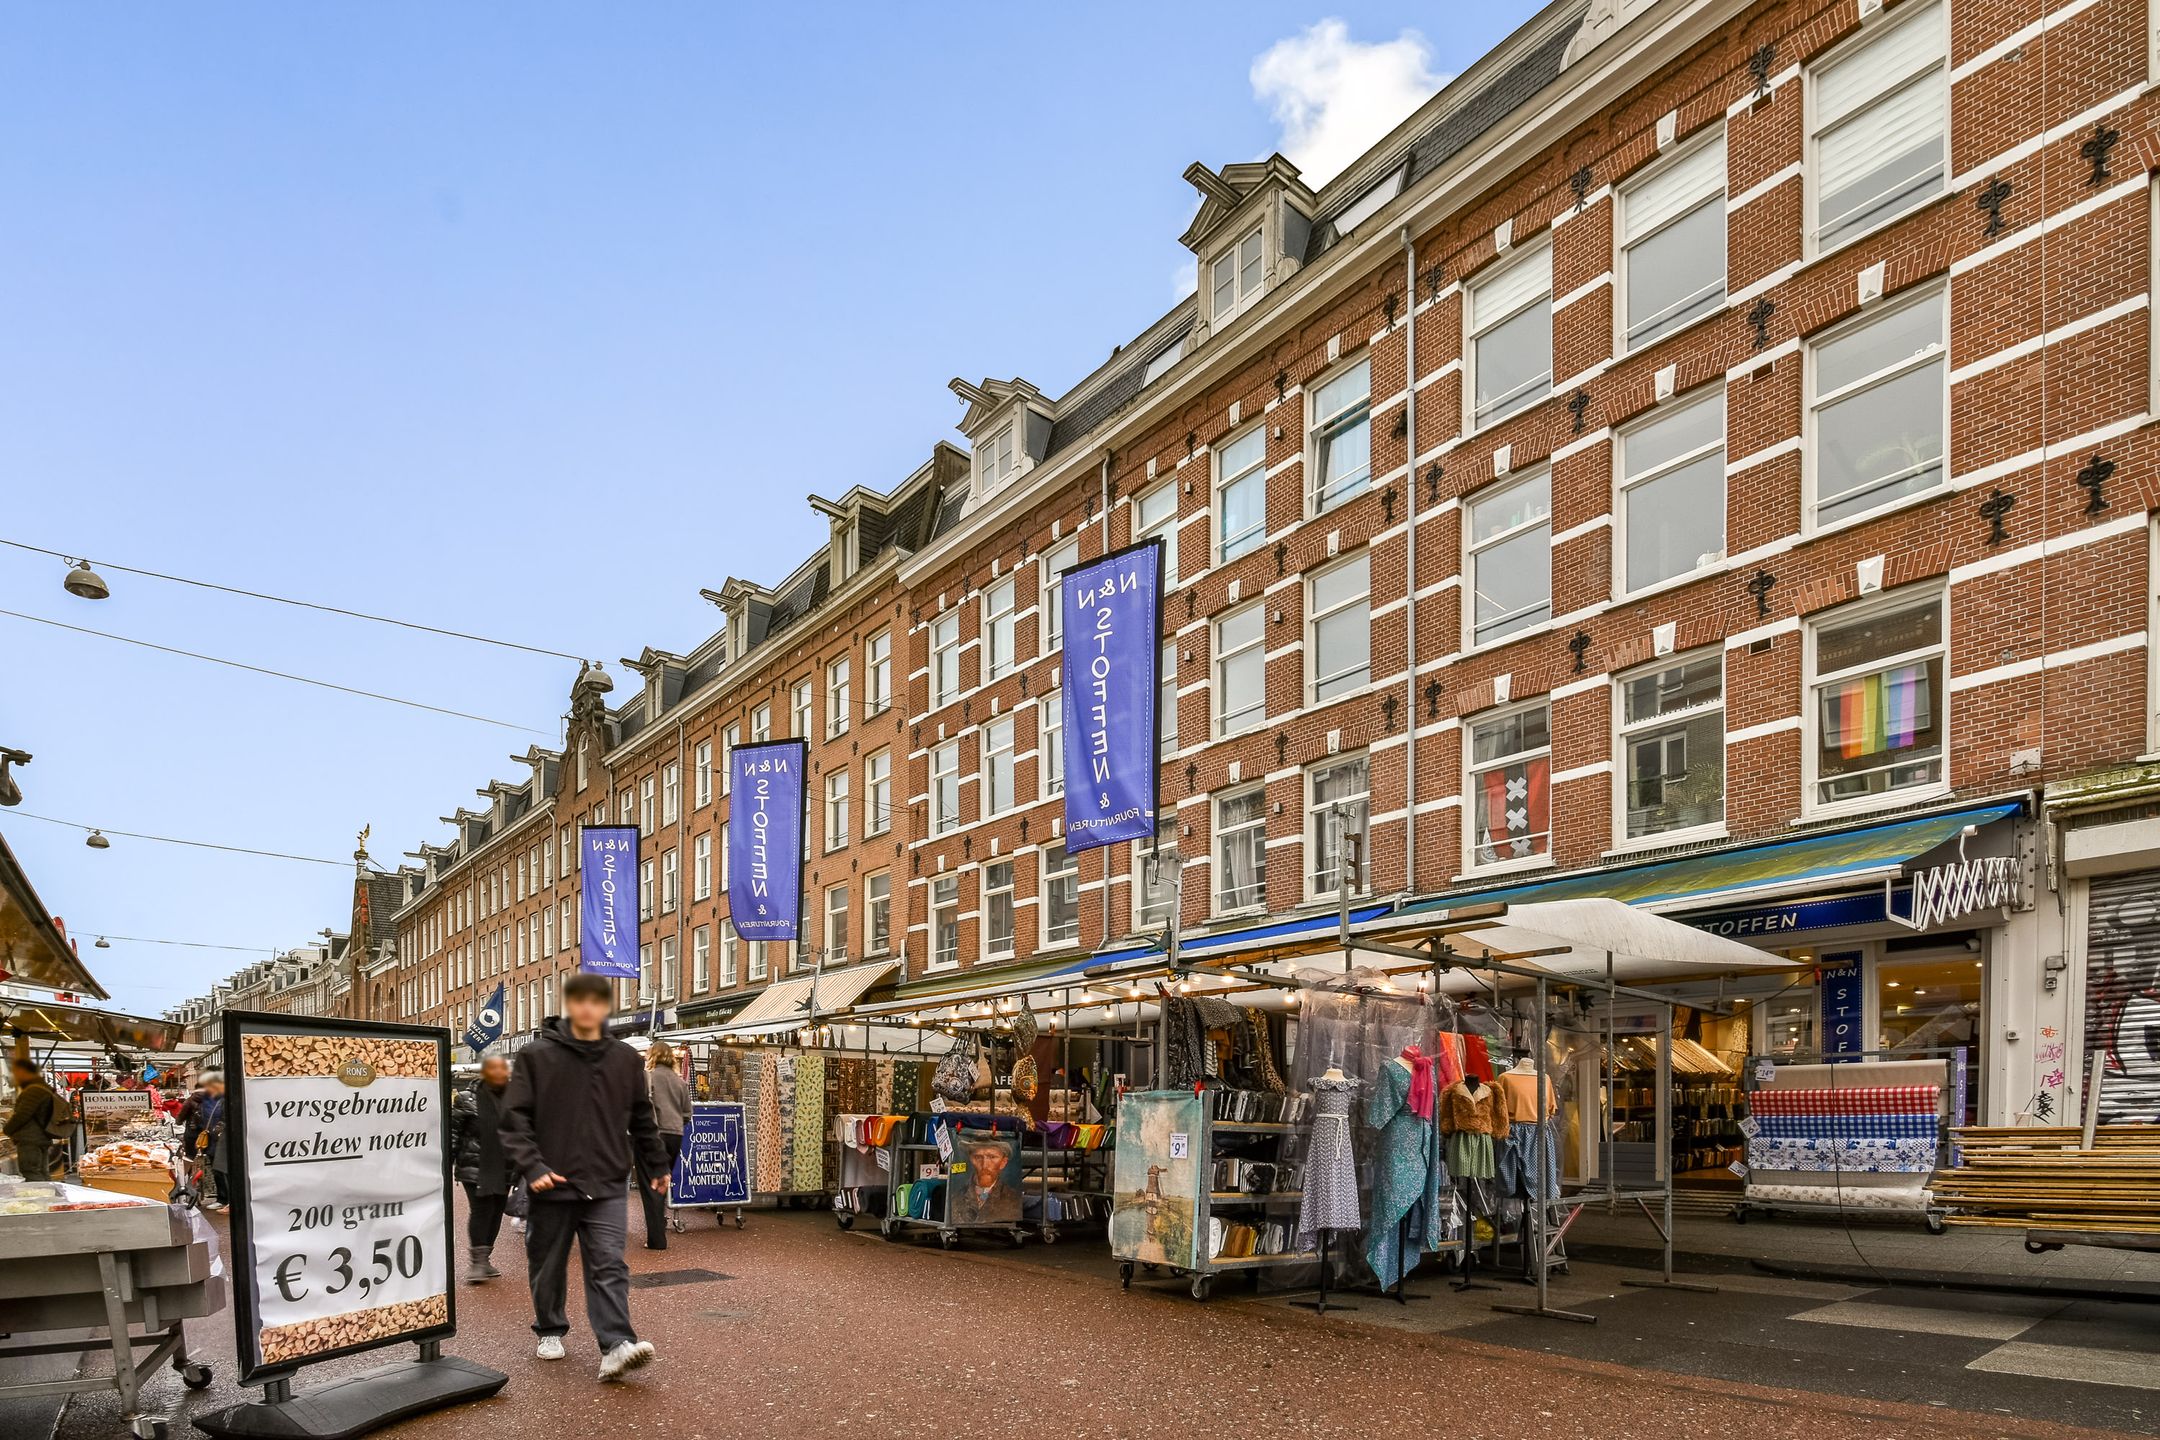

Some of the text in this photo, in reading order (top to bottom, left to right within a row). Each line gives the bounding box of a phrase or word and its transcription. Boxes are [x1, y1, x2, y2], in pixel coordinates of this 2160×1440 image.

[1826, 967, 1857, 979] N&N
[264, 1090, 428, 1124] versgebrande
[689, 1132, 727, 1144] GORDIJN
[264, 1130, 428, 1159] cashew noten
[695, 1151, 726, 1162] METEN
[696, 1163, 726, 1174] MAKEN
[688, 1174, 732, 1186] MONTEREN
[288, 1201, 404, 1232] 200 gram
[273, 1235, 423, 1302] € 3,50
